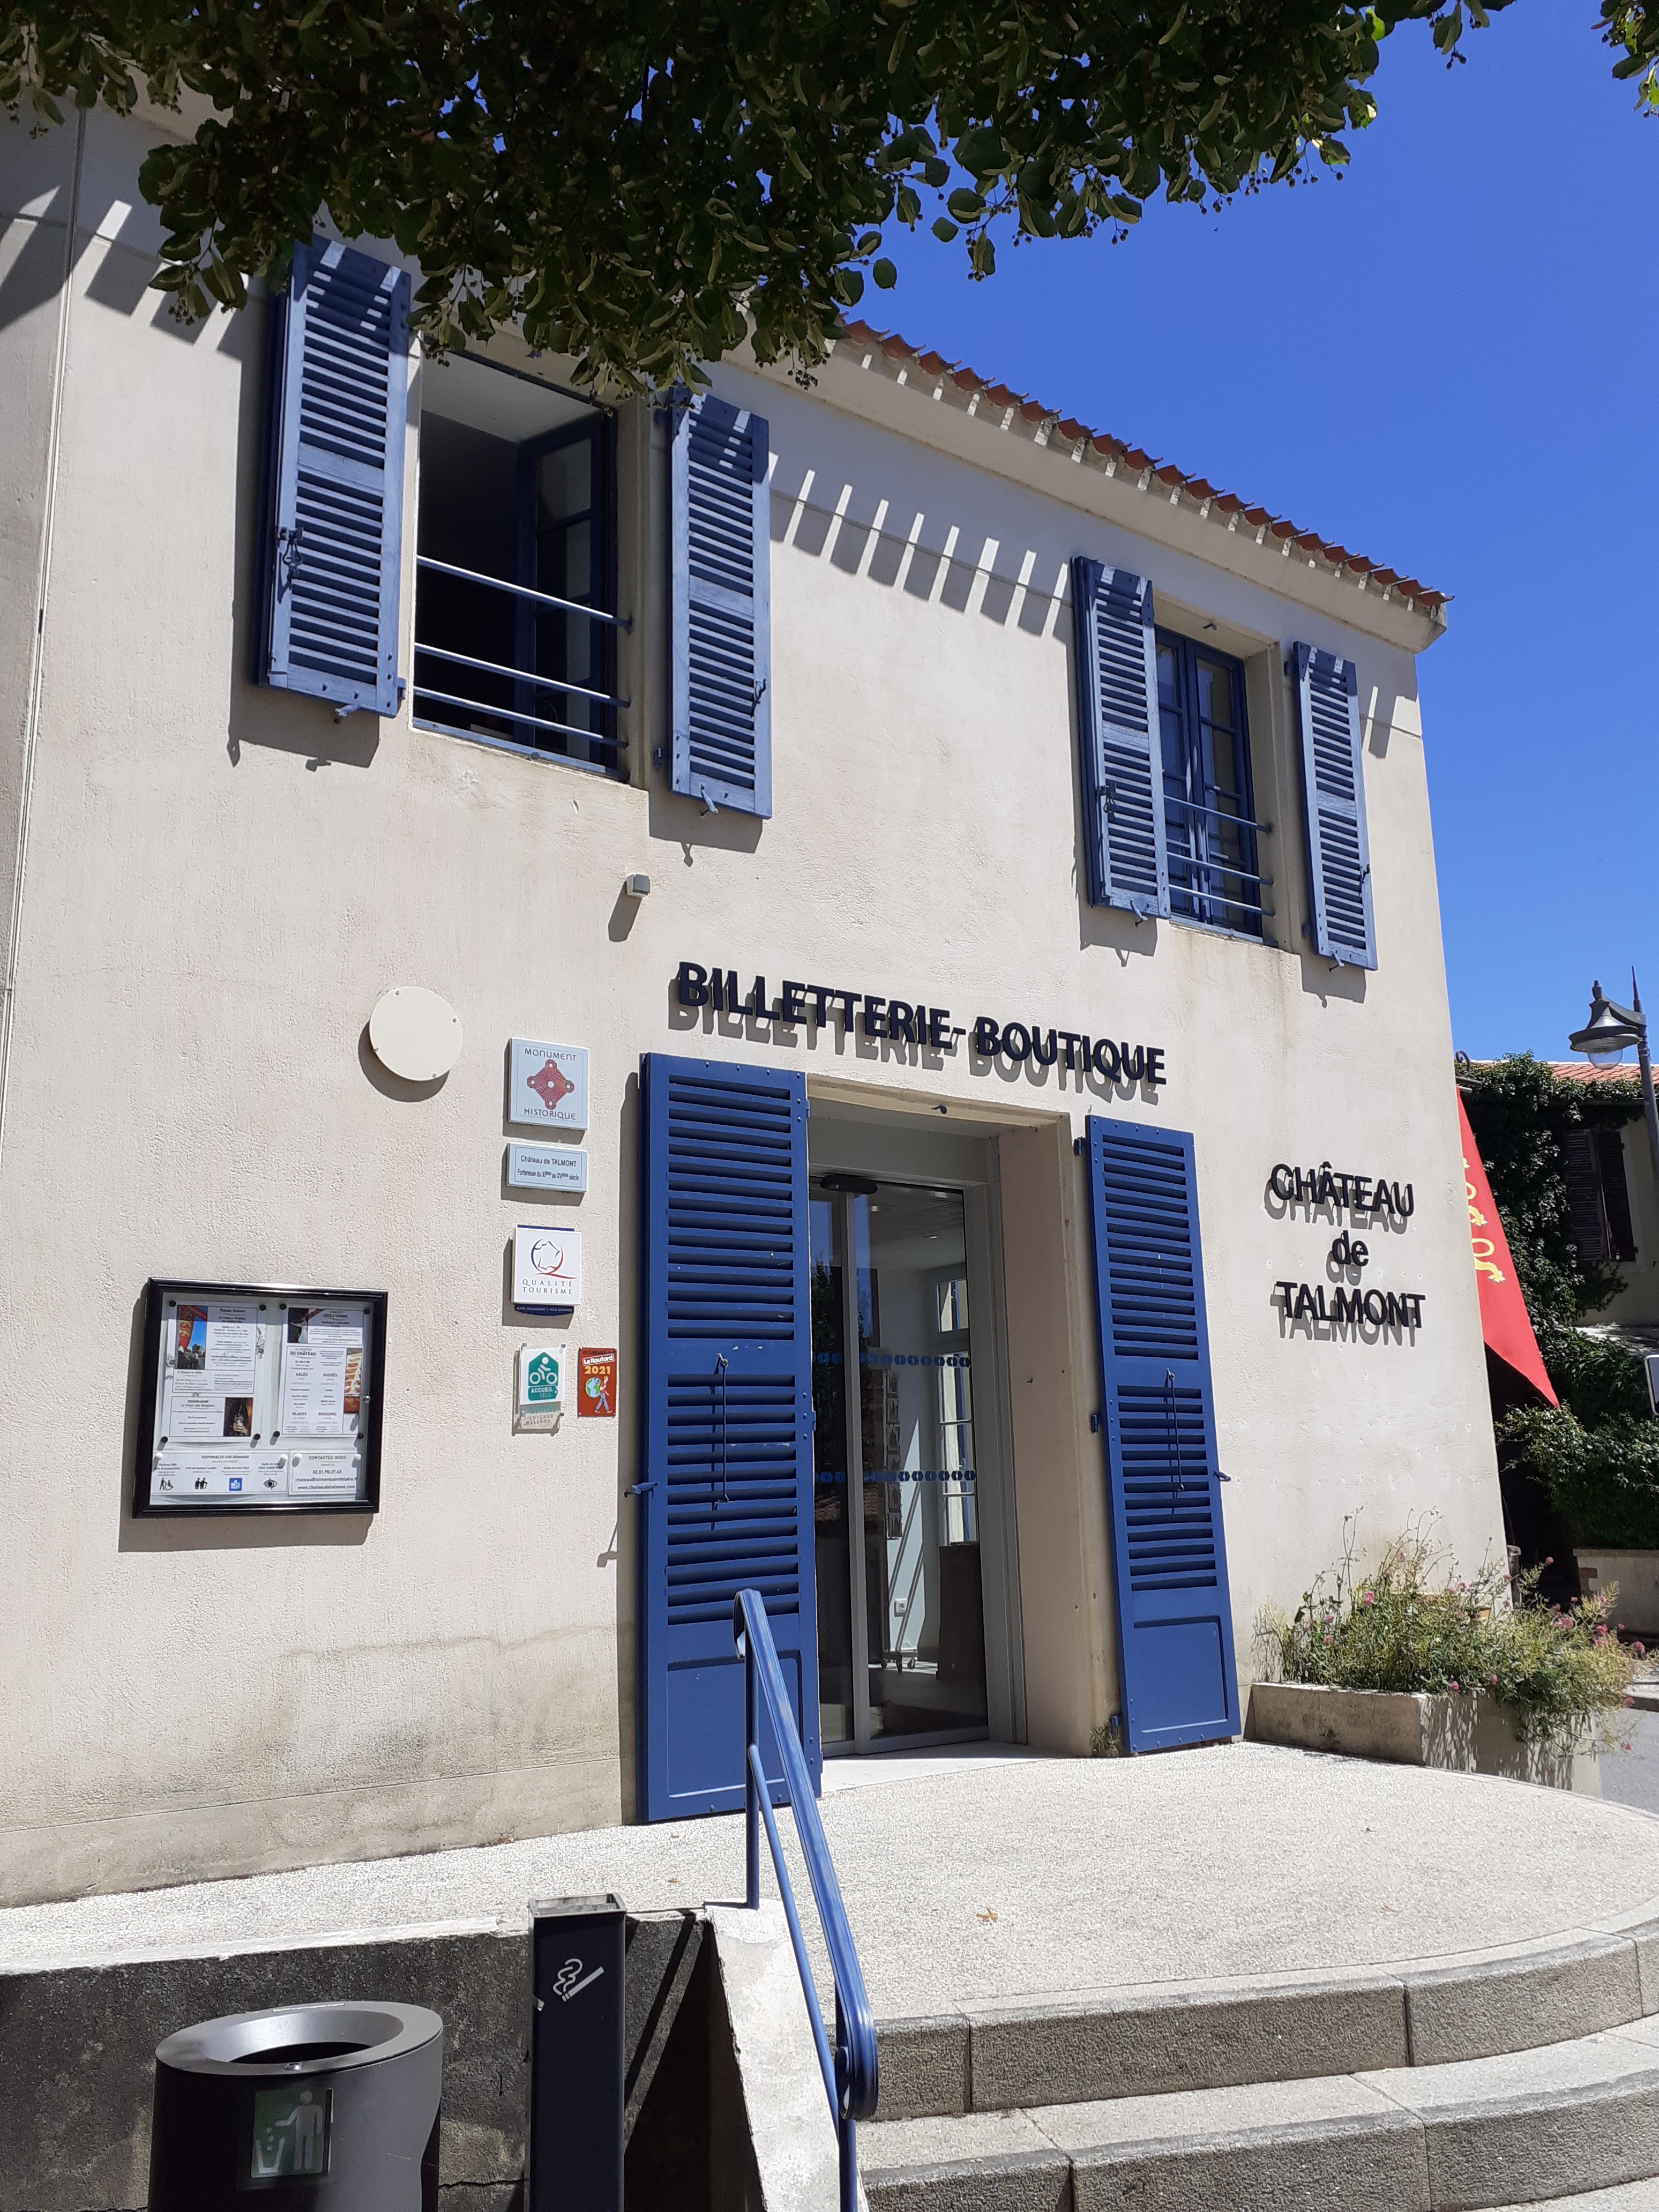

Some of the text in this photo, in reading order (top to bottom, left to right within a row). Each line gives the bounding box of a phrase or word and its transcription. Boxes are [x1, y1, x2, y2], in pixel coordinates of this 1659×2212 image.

[525, 1048, 577, 1062] MONUMENT
[976, 1016, 1167, 1085] BOUTIQUE
[524, 1108, 576, 1120] HISTORIQUE
[520, 1155, 542, 1164] Château
[551, 1158, 577, 1167] TALMONT
[517, 1168, 536, 1177] Forteresse
[1271, 1161, 1415, 1217] CHÂTEAU
[1332, 1230, 1369, 1267] de
[522, 1279, 572, 1287] QUALITÉ
[522, 1287, 572, 1295] TOURISME
[1276, 1281, 1426, 1328] TALMONT
[584, 1365, 611, 1374] 2021
